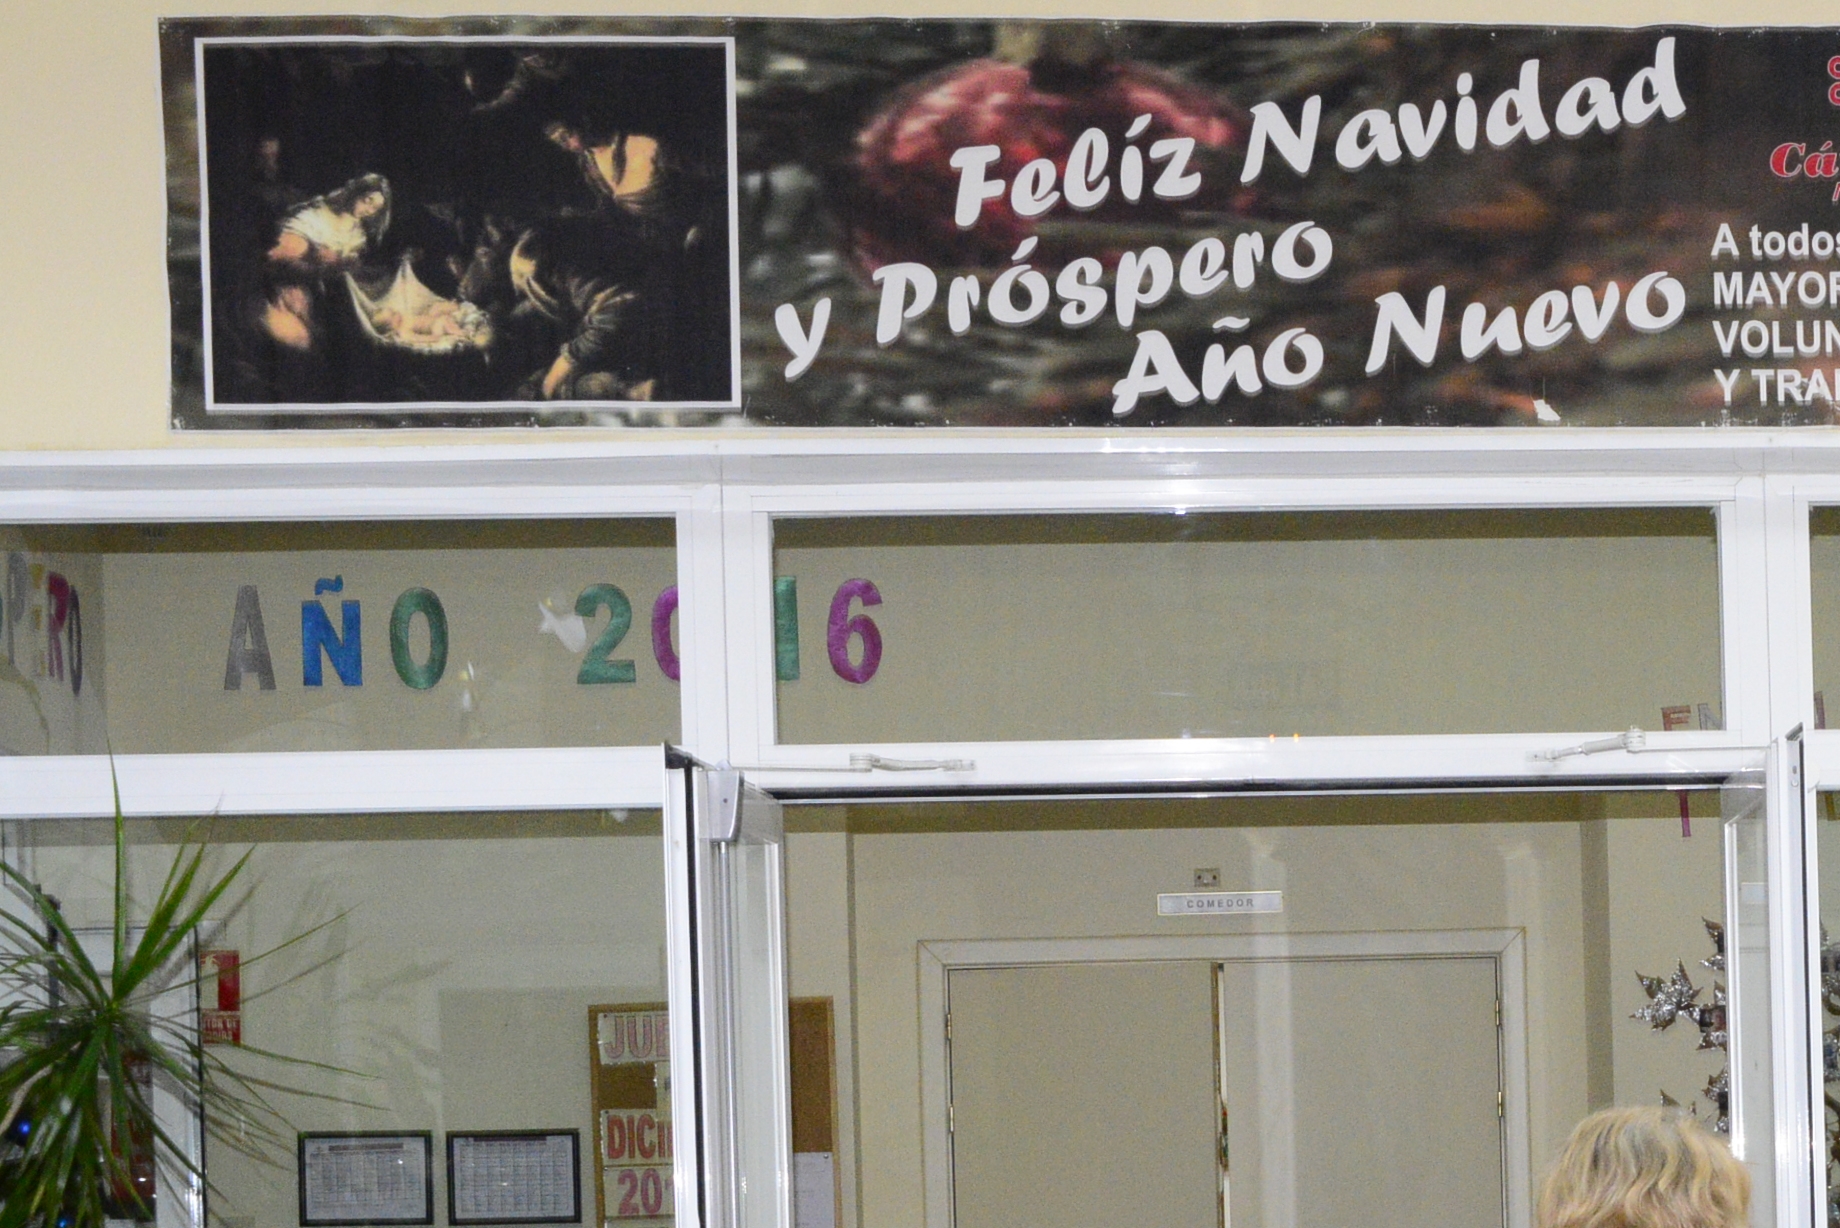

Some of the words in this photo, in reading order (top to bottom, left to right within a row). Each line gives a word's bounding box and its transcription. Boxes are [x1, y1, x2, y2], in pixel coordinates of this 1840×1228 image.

[949, 113, 1201, 229] Felíz
[1240, 36, 1688, 186] Navidad
[1711, 223, 1738, 258] A
[774, 297, 832, 382] y
[872, 220, 1335, 345] Próspero
[1112, 315, 1326, 416] Año
[1364, 270, 1688, 376] Nuevo
[1714, 369, 1740, 405] Y
[223, 574, 449, 691] AÑO
[1187, 898, 1254, 909] COMEDOR
